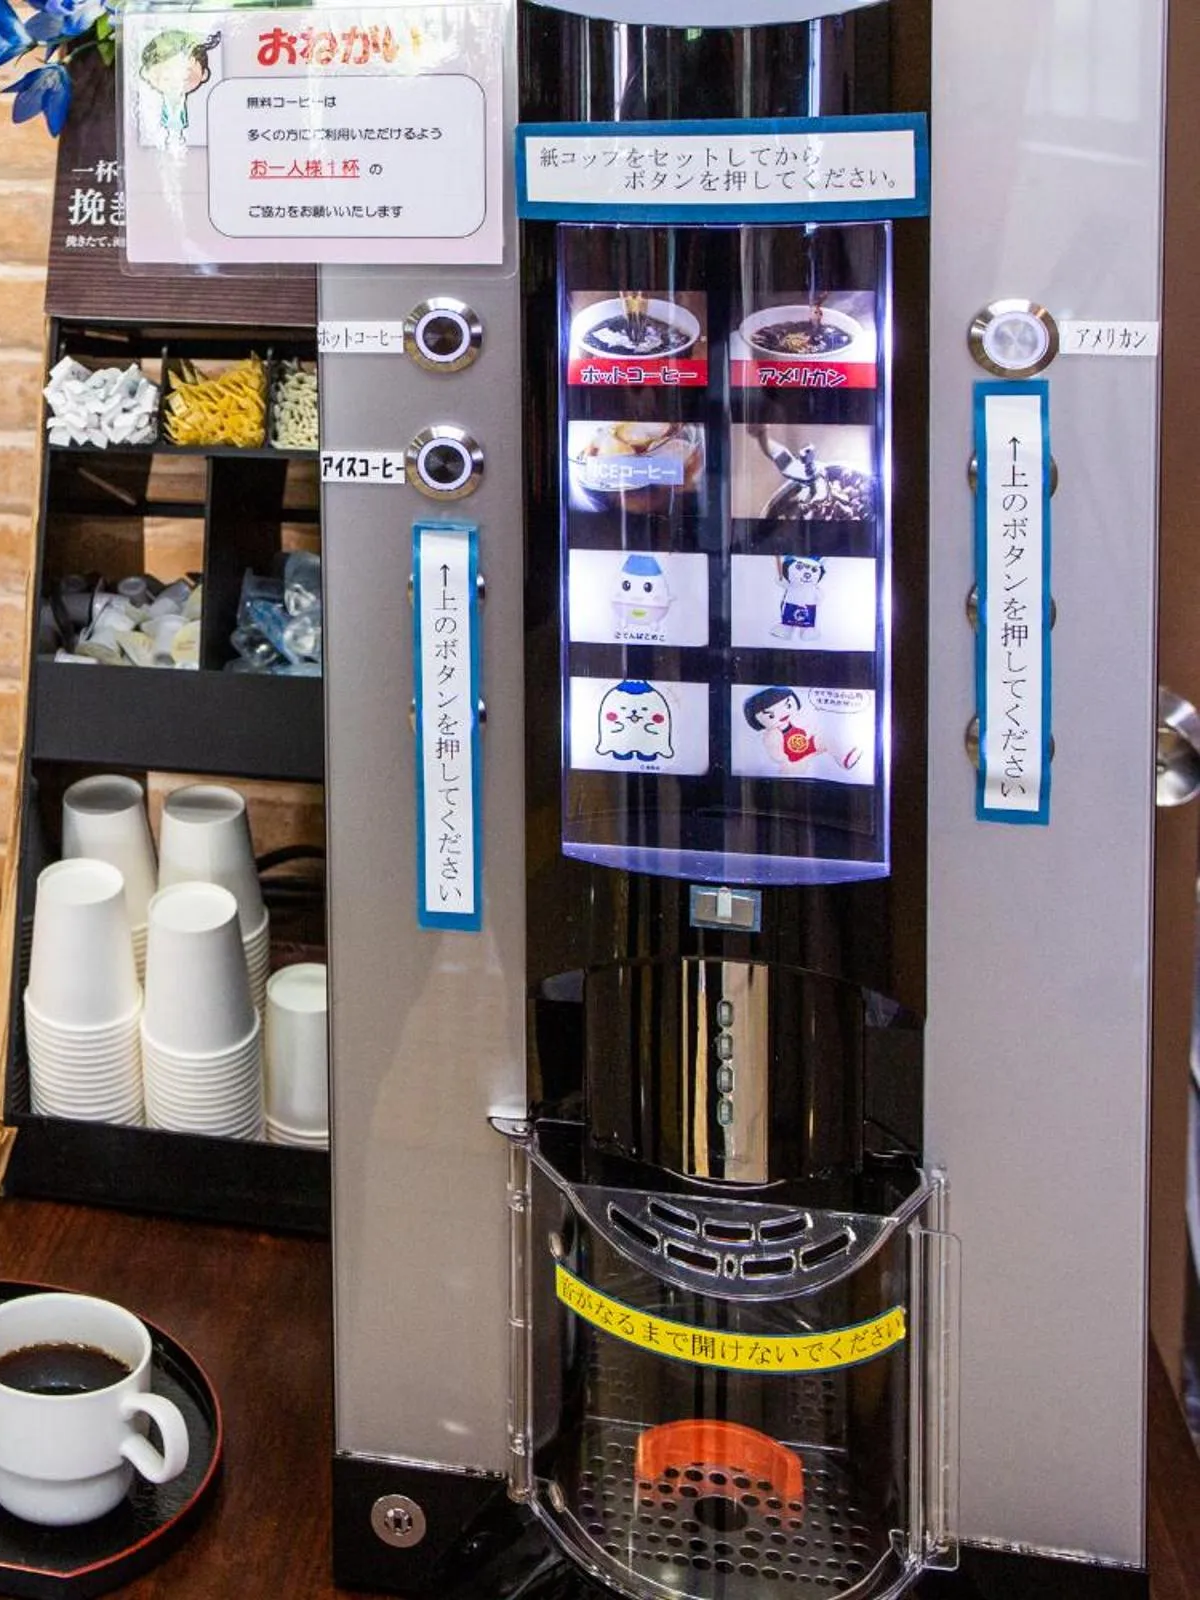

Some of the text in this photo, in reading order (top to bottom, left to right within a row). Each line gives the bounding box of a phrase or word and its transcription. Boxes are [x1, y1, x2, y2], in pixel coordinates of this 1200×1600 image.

[246, 96, 337, 109] 無料コーヒーは
[247, 128, 443, 142] 多くの方にご利用いただけるよう
[369, 163, 383, 176] の
[624, 167, 899, 191] ボタンを押してください。
[248, 205, 404, 219] ご協力をお願いいたします
[318, 327, 403, 348] ホットコーヒー
[1075, 326, 1148, 348] アメリカン
[580, 366, 698, 385] ホットコーヒー
[758, 367, 848, 388] アメリカン
[322, 456, 405, 479] アイスコーヒー
[1000, 464, 1030, 798] 上のボタンを押してください
[434, 588, 462, 901] 上のボタンを押してください
[558, 1277, 901, 1365] 音がなるまで開けないでください
